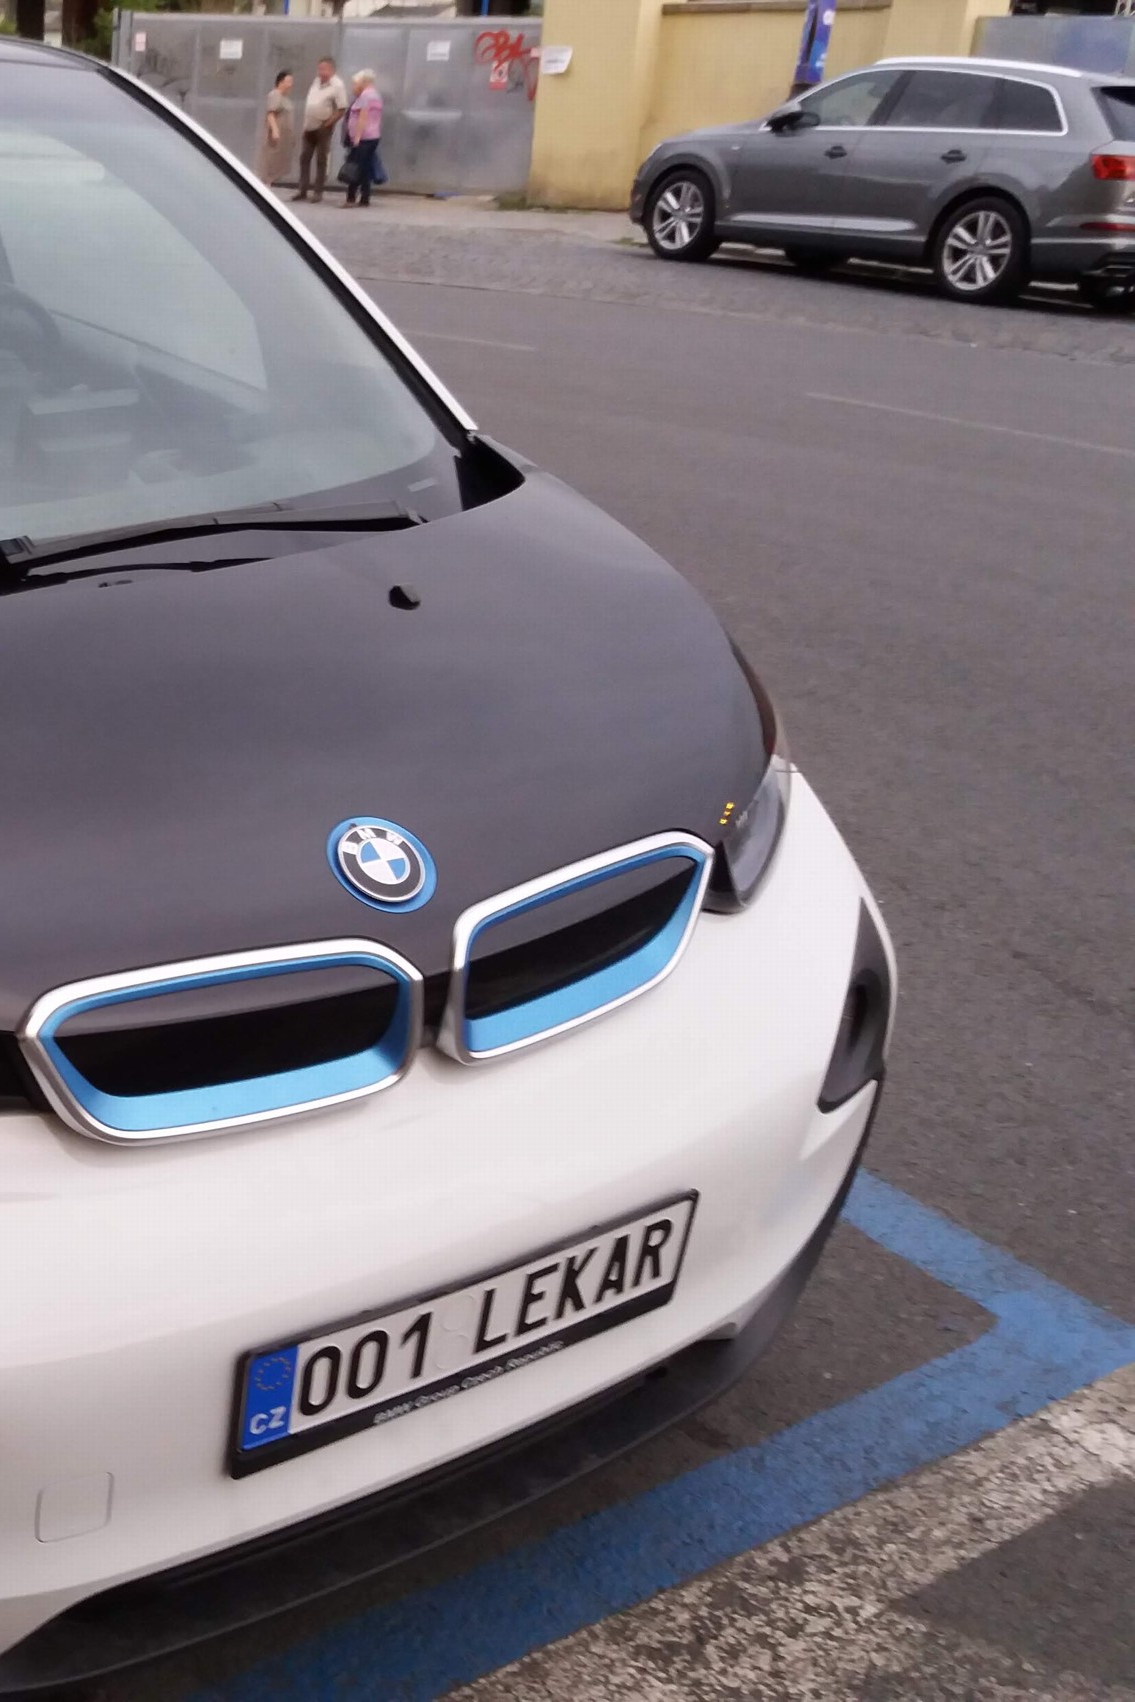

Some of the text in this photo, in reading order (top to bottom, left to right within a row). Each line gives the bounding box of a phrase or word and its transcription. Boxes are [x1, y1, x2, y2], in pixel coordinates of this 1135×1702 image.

[341, 827, 404, 855] BMW
[299, 1312, 431, 1416] 001
[474, 1218, 673, 1354] LEKAR
[248, 1406, 285, 1435] CZ
